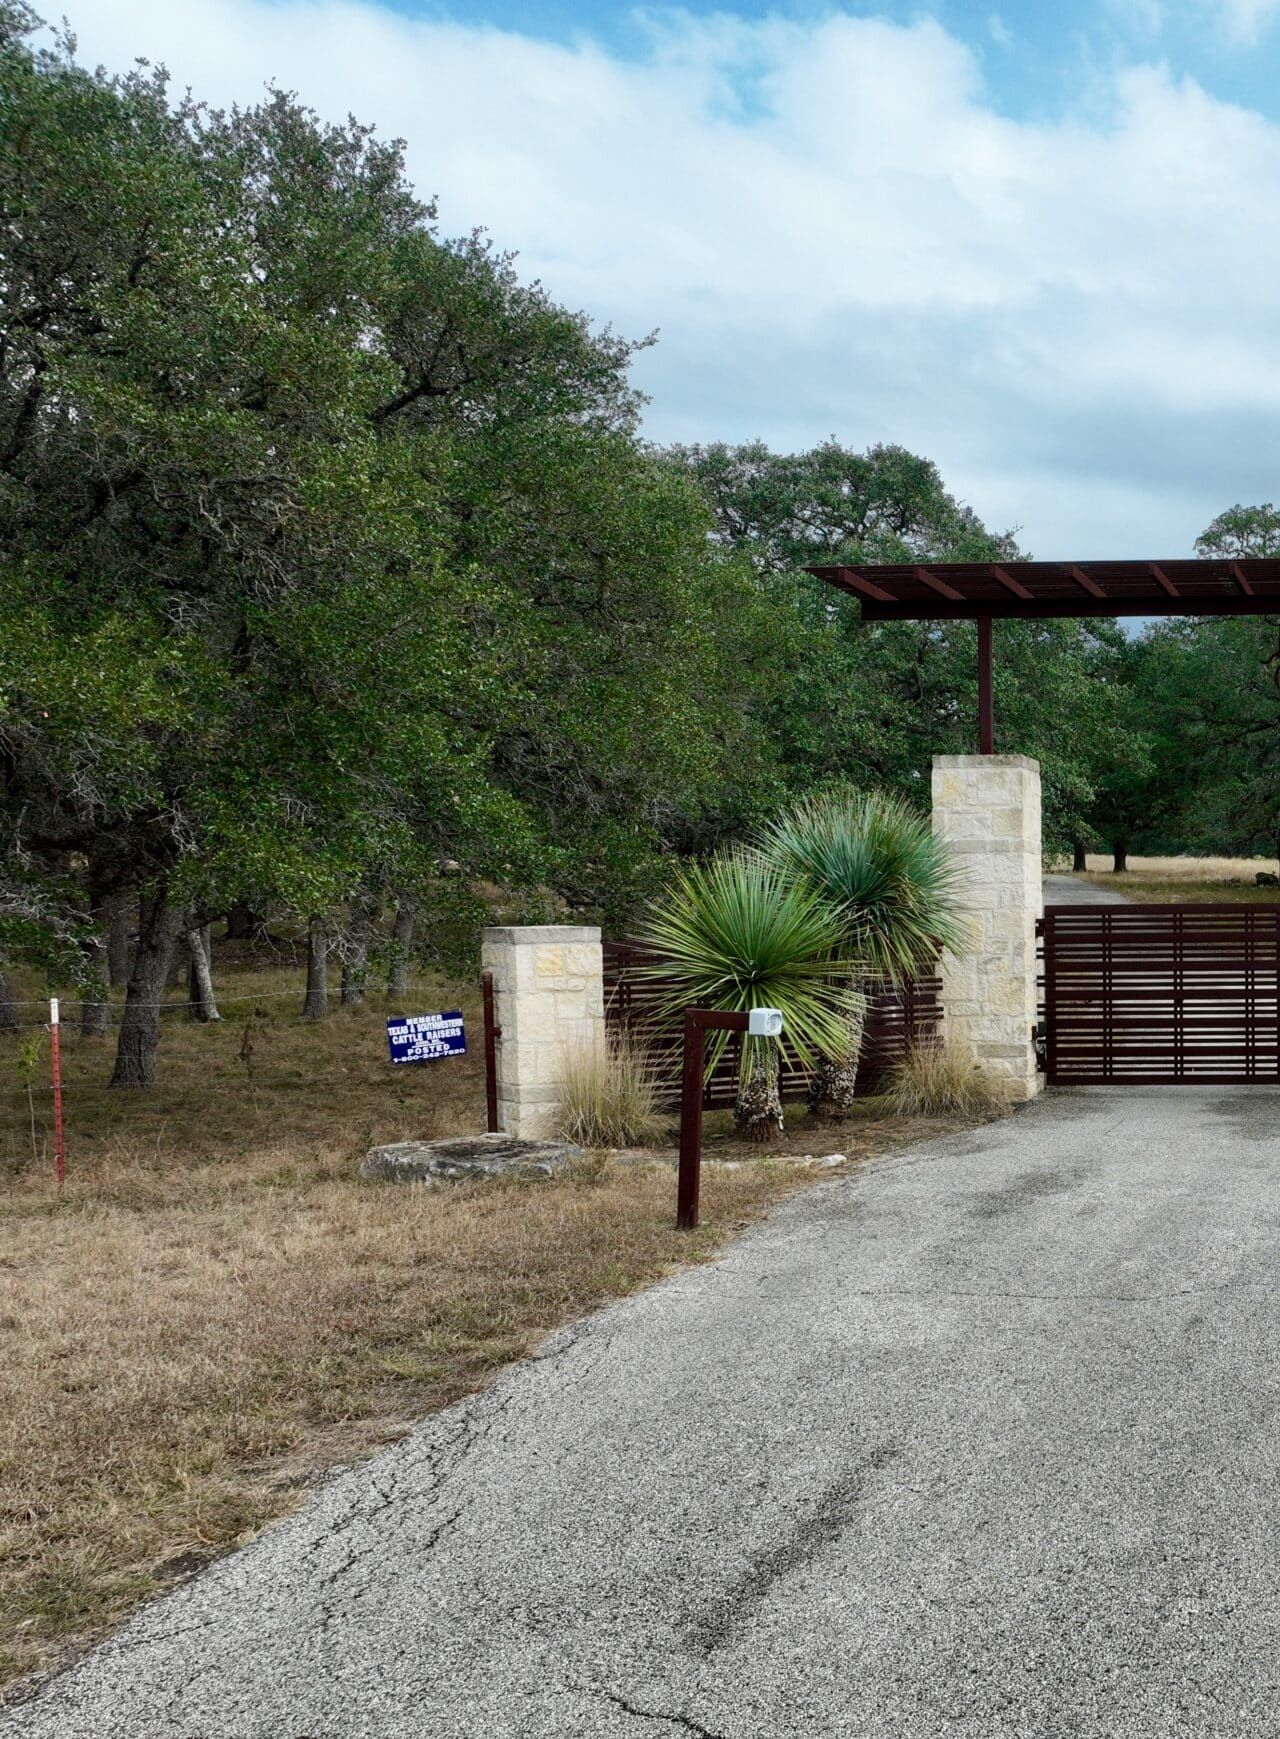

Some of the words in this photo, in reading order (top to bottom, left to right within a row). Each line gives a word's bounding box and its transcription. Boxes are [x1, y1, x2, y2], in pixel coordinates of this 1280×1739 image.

[406, 1015, 442, 1026] MEMBER
[388, 1025, 409, 1036] TEXAS
[392, 1033, 423, 1045] CATTLE
[426, 1027, 461, 1040] RAISERS
[407, 1044, 450, 1055] POSTED
